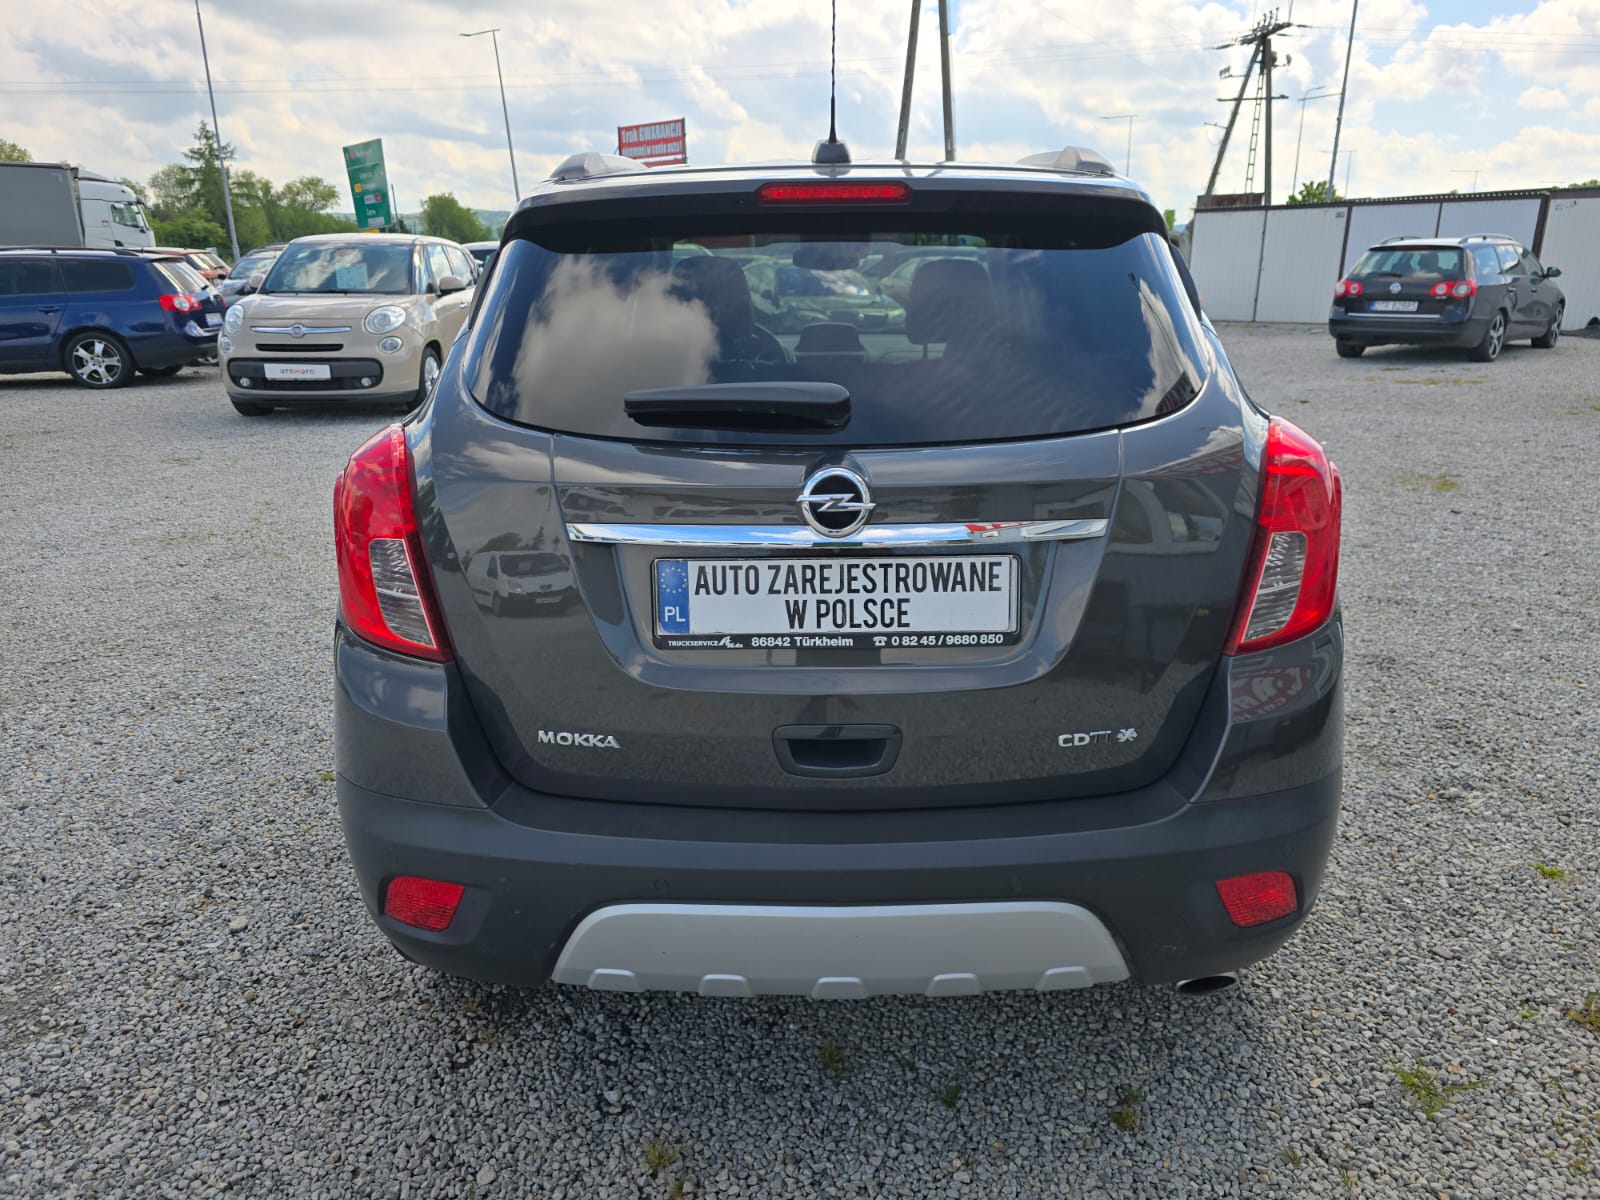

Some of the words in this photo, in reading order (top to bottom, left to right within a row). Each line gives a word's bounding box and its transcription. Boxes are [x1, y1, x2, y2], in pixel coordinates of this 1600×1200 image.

[694, 565, 760, 595] AUTO
[767, 562, 1002, 595] ZAREJESTROWANE
[664, 606, 686, 622] PL
[785, 599, 807, 629] W
[816, 598, 911, 629] POLSCE
[751, 636, 791, 647] 86842
[794, 636, 854, 647] Türkheim
[537, 729, 621, 749] MOKKA
